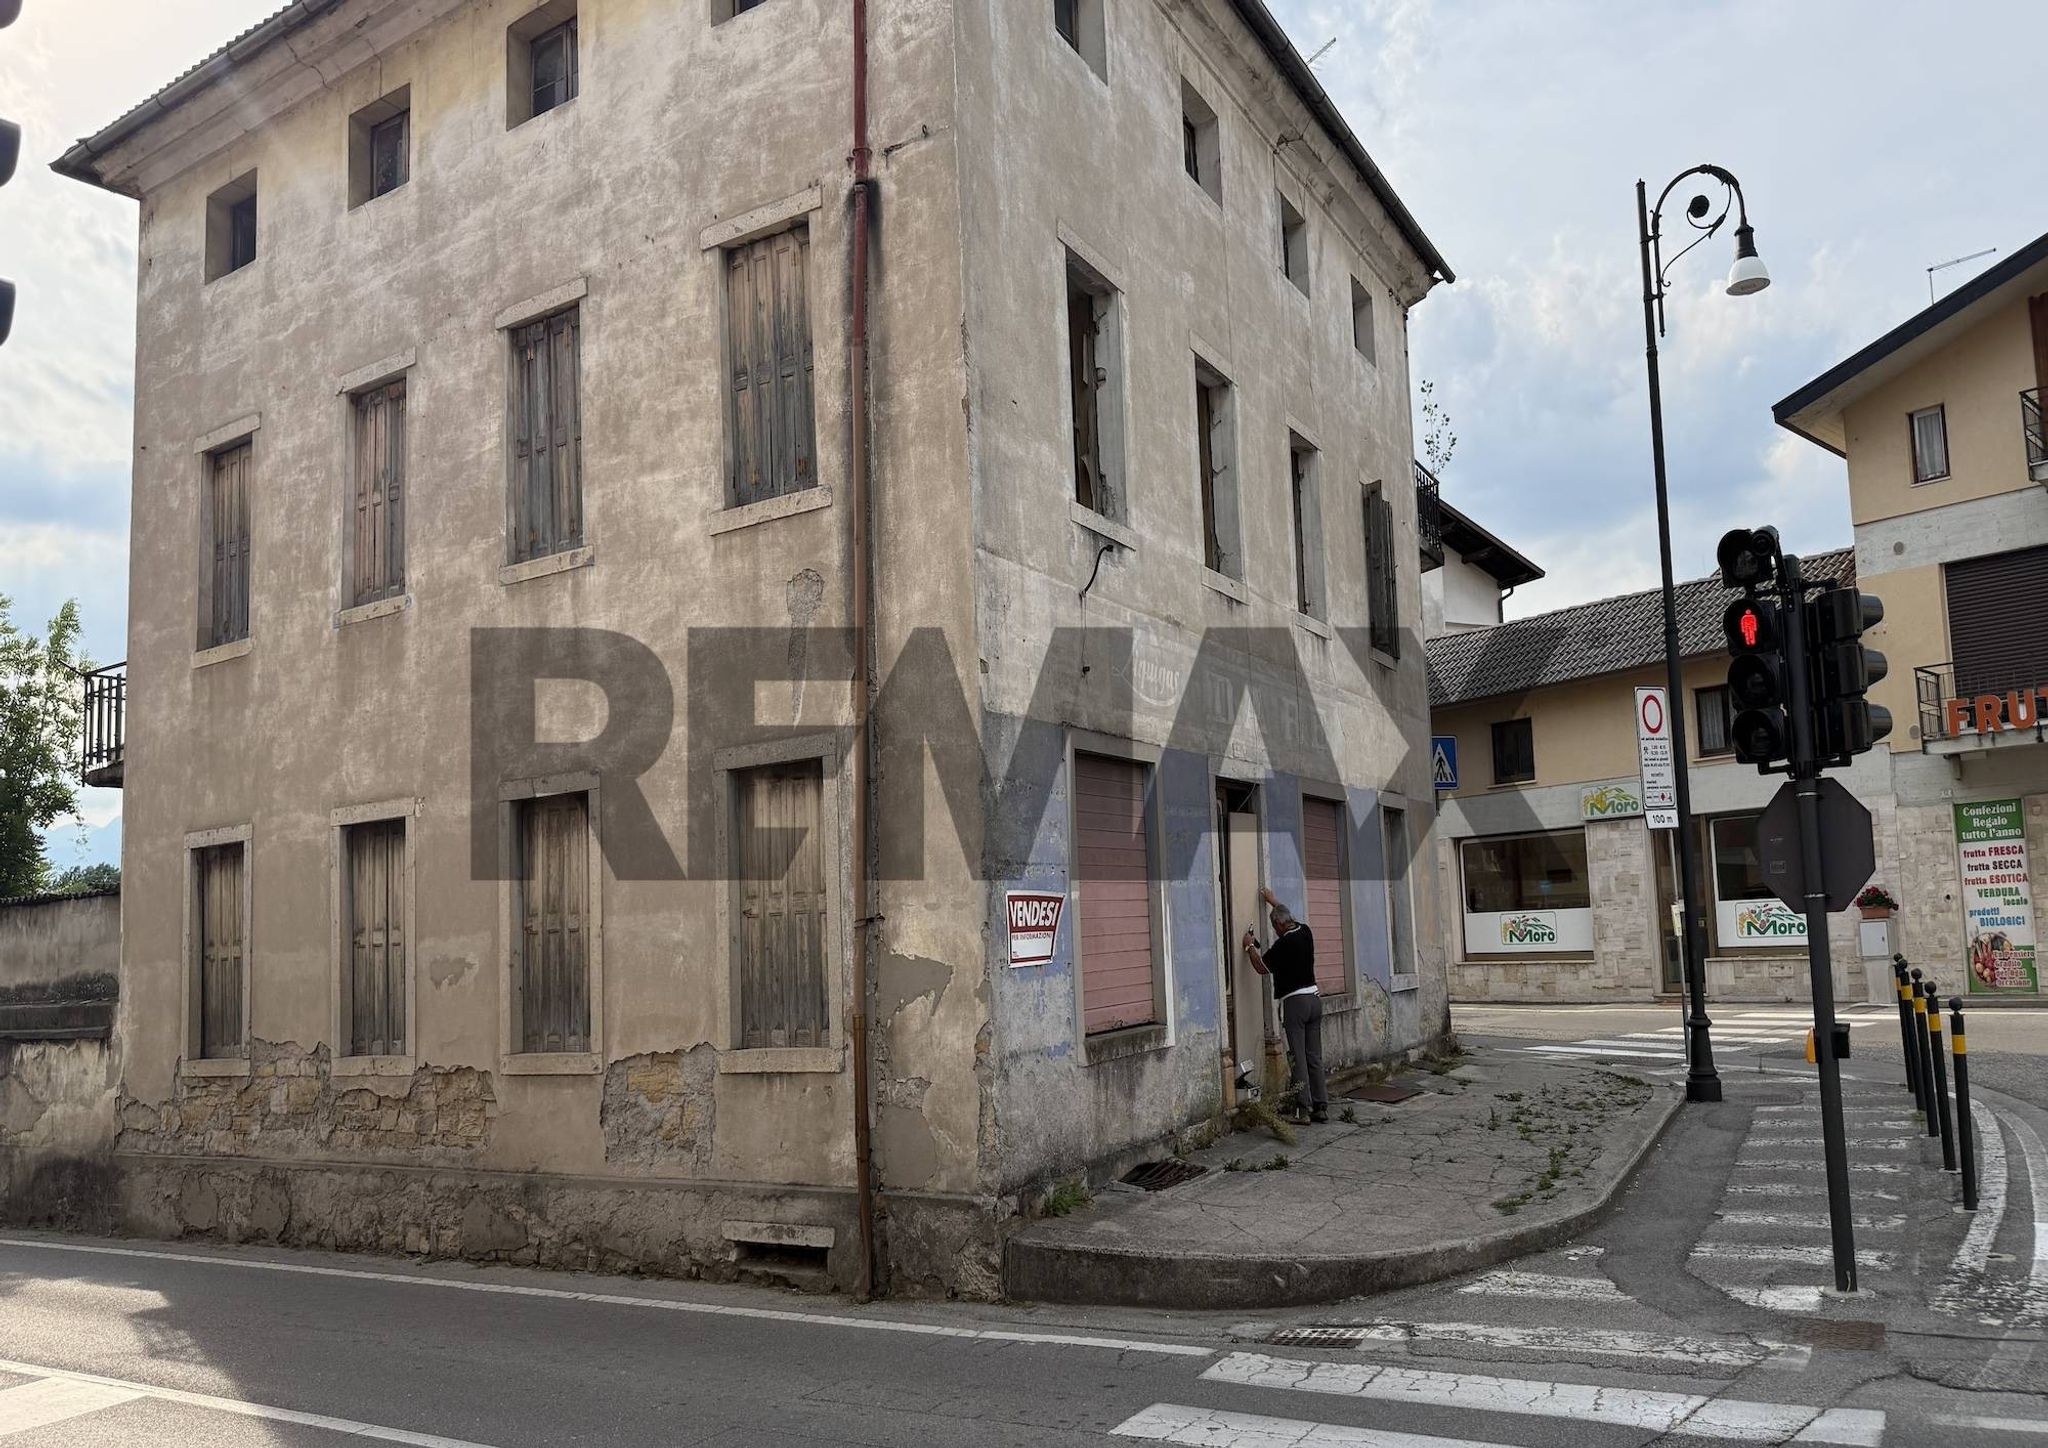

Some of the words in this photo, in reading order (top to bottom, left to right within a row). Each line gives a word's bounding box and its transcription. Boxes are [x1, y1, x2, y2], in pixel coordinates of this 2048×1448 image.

[1590, 800, 1639, 815] Moro
[1963, 803, 2017, 817] Confezioni
[1652, 814, 1665, 823] 100
[1973, 816, 2008, 828] Regalo
[1962, 831, 1987, 840] tutto
[1989, 828, 2021, 837] l'anno
[1964, 850, 1986, 858] frutta
[1988, 845, 2024, 856] FRESCA
[1968, 863, 1990, 871] frutta
[1993, 860, 2023, 870] SECCA
[1965, 877, 1987, 885] frutta
[1989, 873, 2029, 884] ESOTICA
[1977, 887, 2020, 897] VERDURA
[2003, 897, 2028, 905] locale
[1009, 901, 1060, 927] VENDESI
[1969, 907, 2000, 917] prodotti
[1980, 916, 2025, 926] BIOLOGICI
[1747, 920, 1806, 935] Moro
[1509, 929, 1555, 942] Moro
